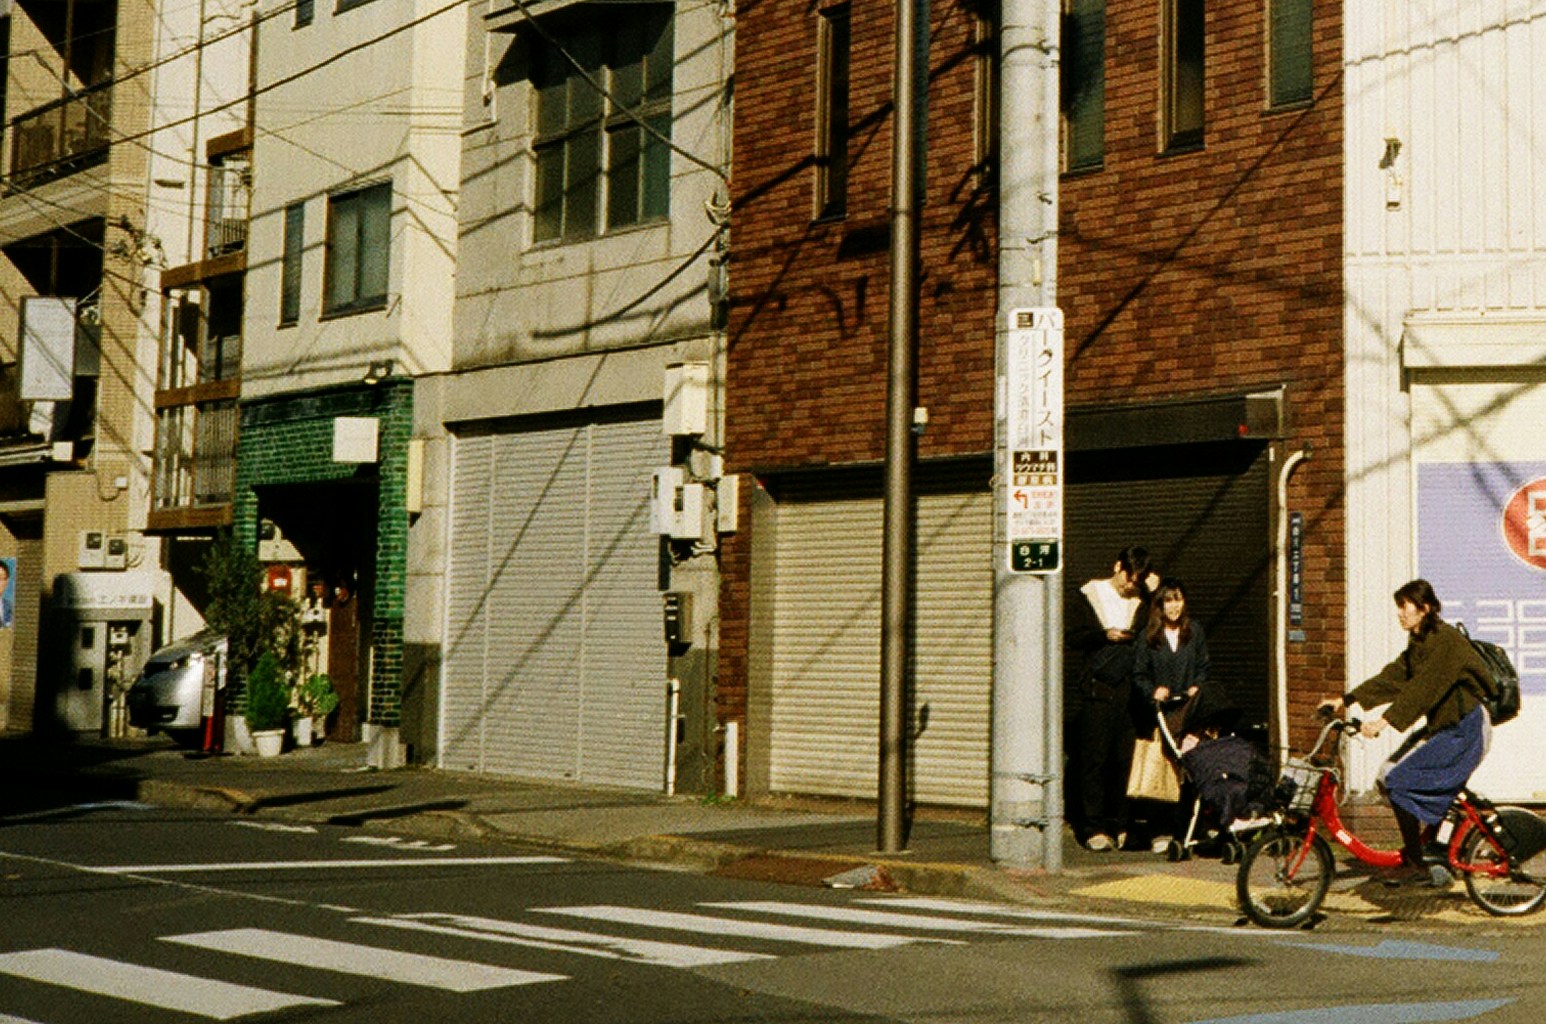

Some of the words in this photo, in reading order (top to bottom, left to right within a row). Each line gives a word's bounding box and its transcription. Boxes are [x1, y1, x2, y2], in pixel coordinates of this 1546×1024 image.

[1036, 311, 1056, 447] パークイースト
